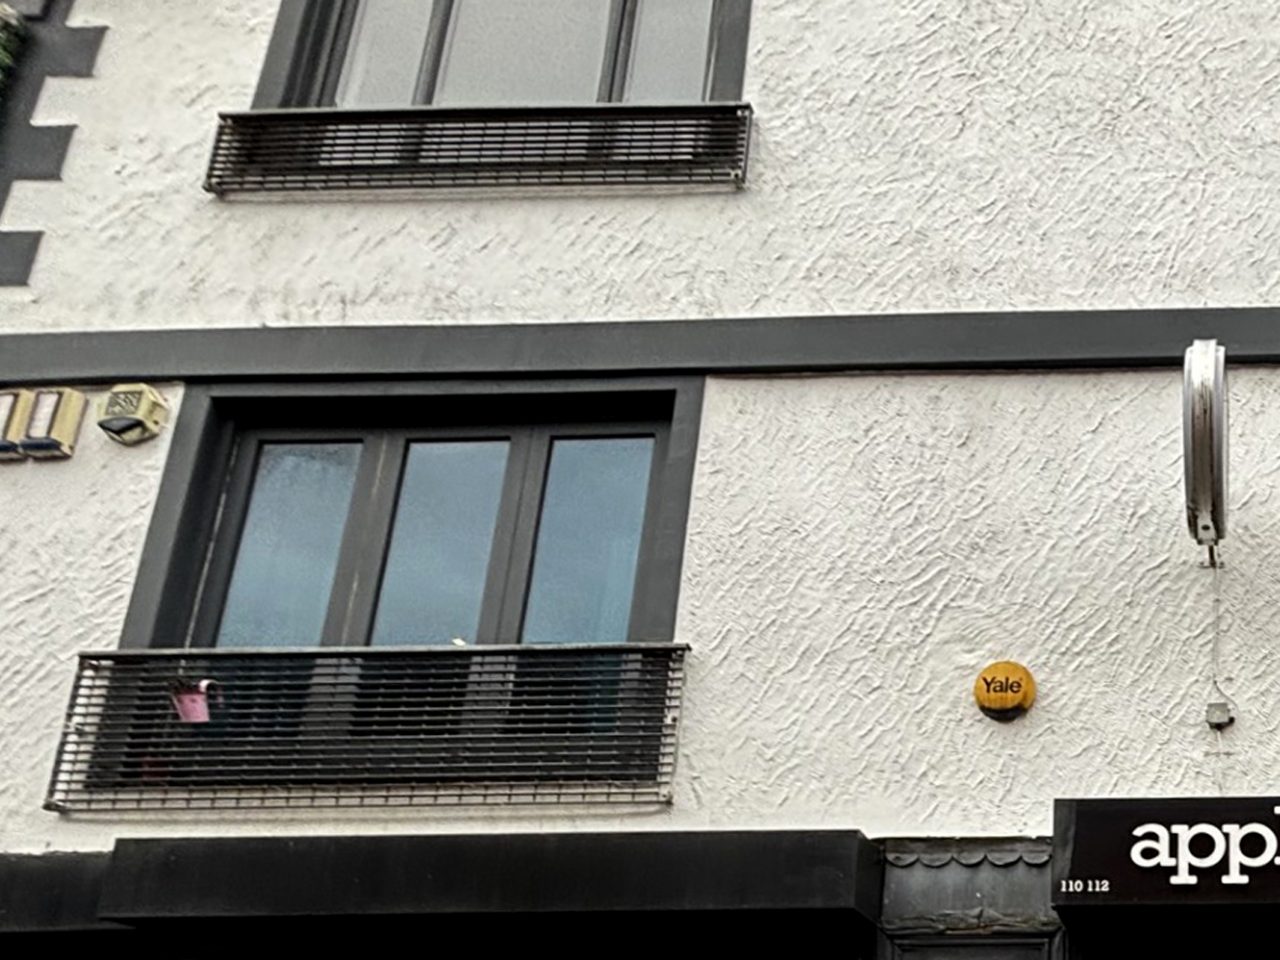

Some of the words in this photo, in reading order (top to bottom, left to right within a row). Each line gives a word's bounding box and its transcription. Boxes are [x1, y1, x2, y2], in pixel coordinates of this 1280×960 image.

[982, 676, 1022, 694] Yale
[1061, 880, 1083, 892] 110
[1088, 880, 1109, 891] 112
